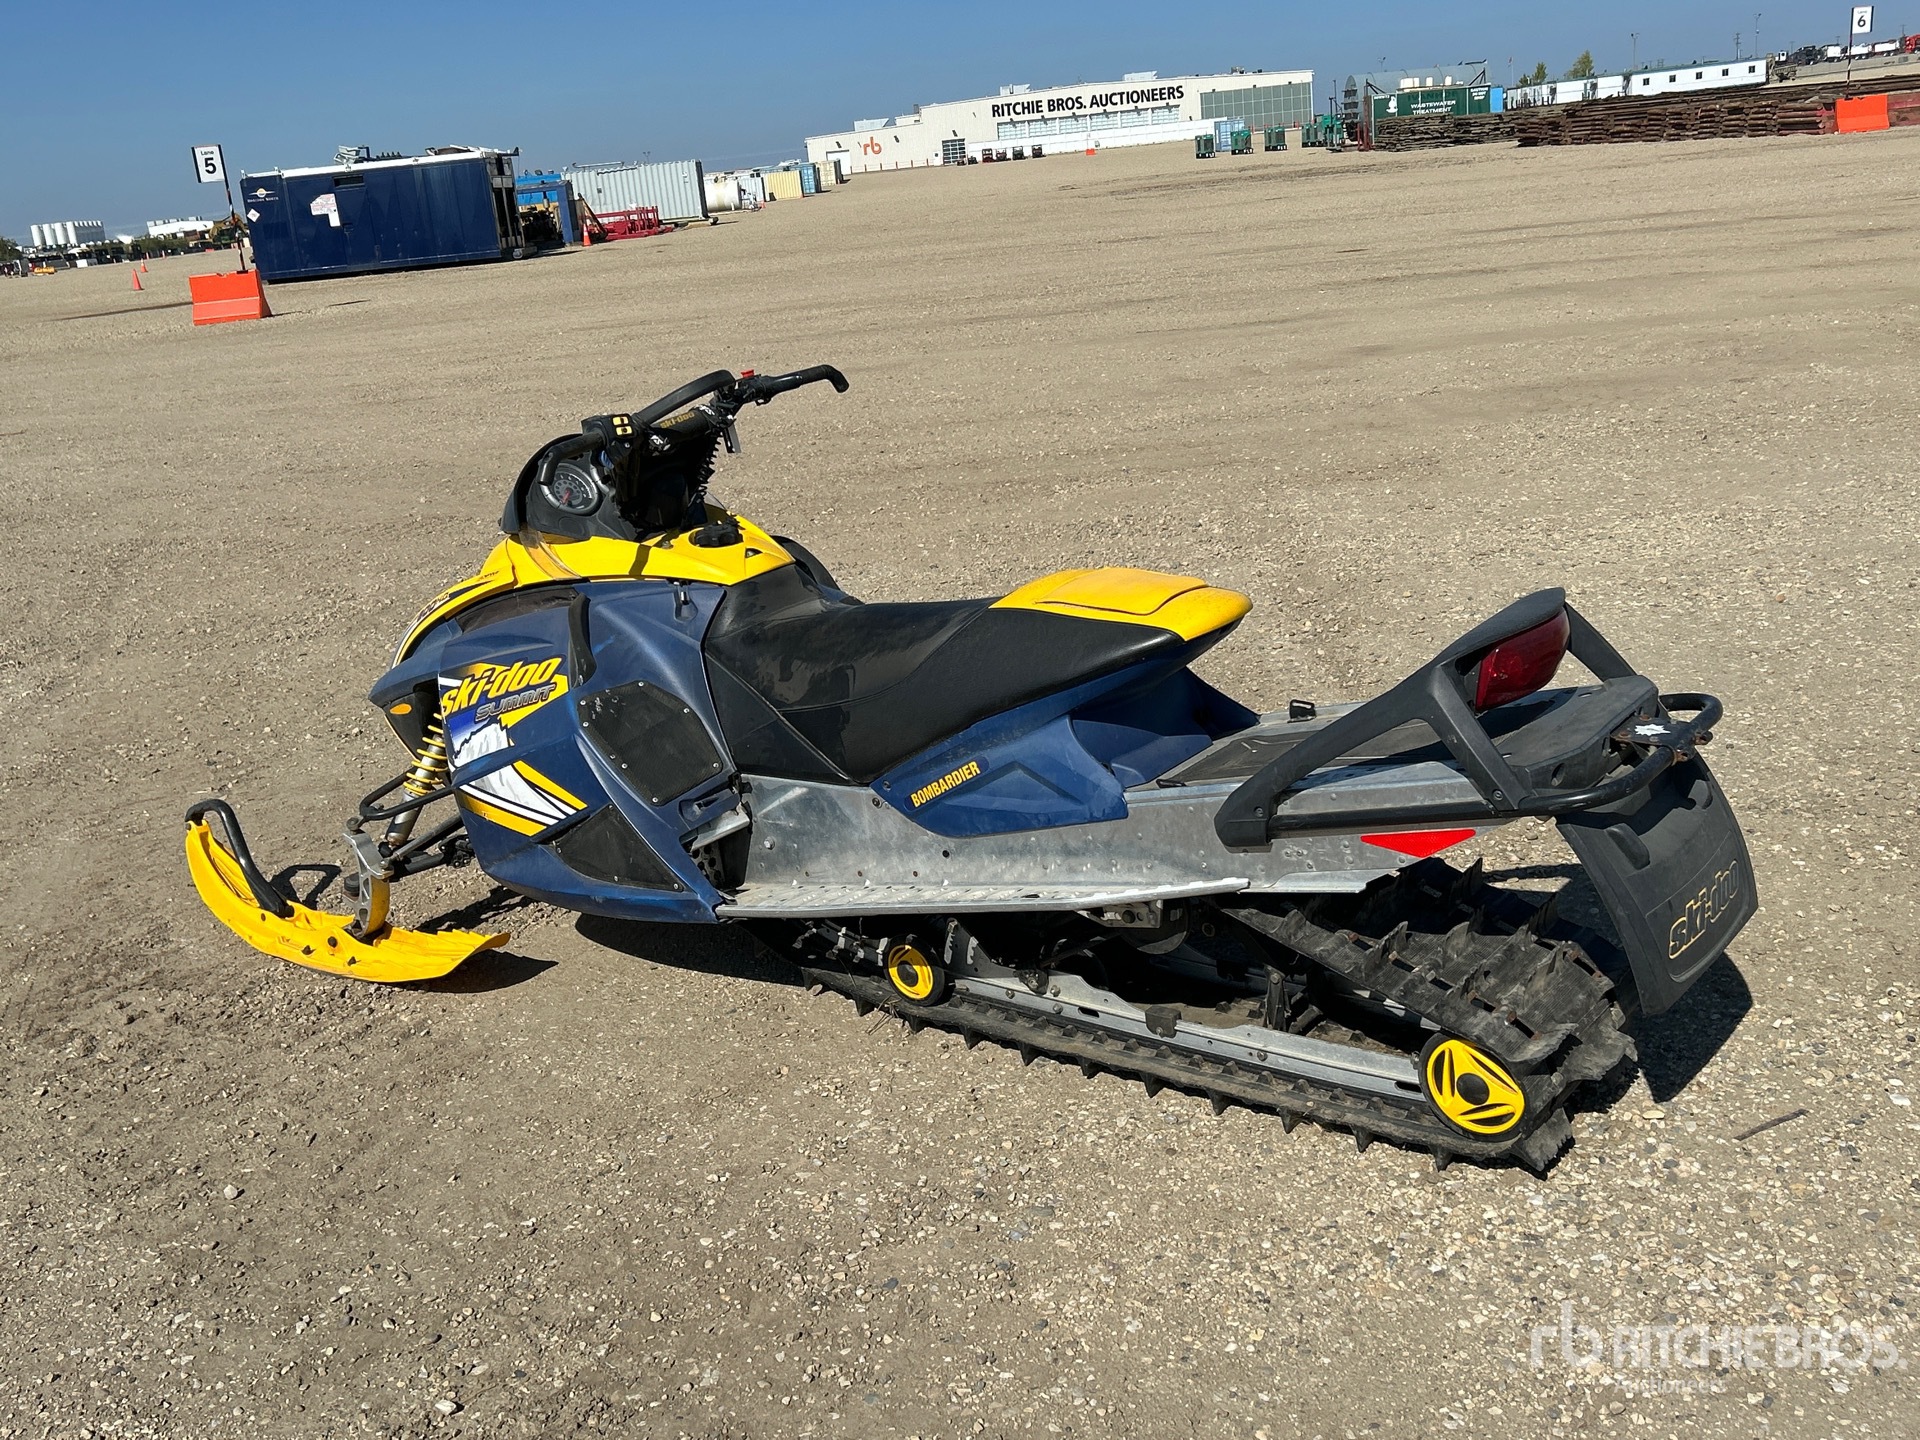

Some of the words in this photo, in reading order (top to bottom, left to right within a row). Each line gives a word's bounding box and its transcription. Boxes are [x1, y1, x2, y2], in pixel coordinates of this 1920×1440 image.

[1857, 15, 1866, 27] 6
[992, 100, 1043, 117] RITCHIE
[1047, 96, 1087, 112] BROS.
[1089, 85, 1184, 108] AUCTIONEERS
[1410, 100, 1456, 109] WASTEWATER
[1413, 107, 1452, 115] TREATMENT
[863, 136, 883, 156] rb
[204, 157, 217, 174] 5
[441, 657, 562, 716] ski-doo
[475, 684, 556, 722] SUMMIT
[910, 761, 981, 808] BOMBARDIER
[1669, 860, 1738, 959] ski-doo
